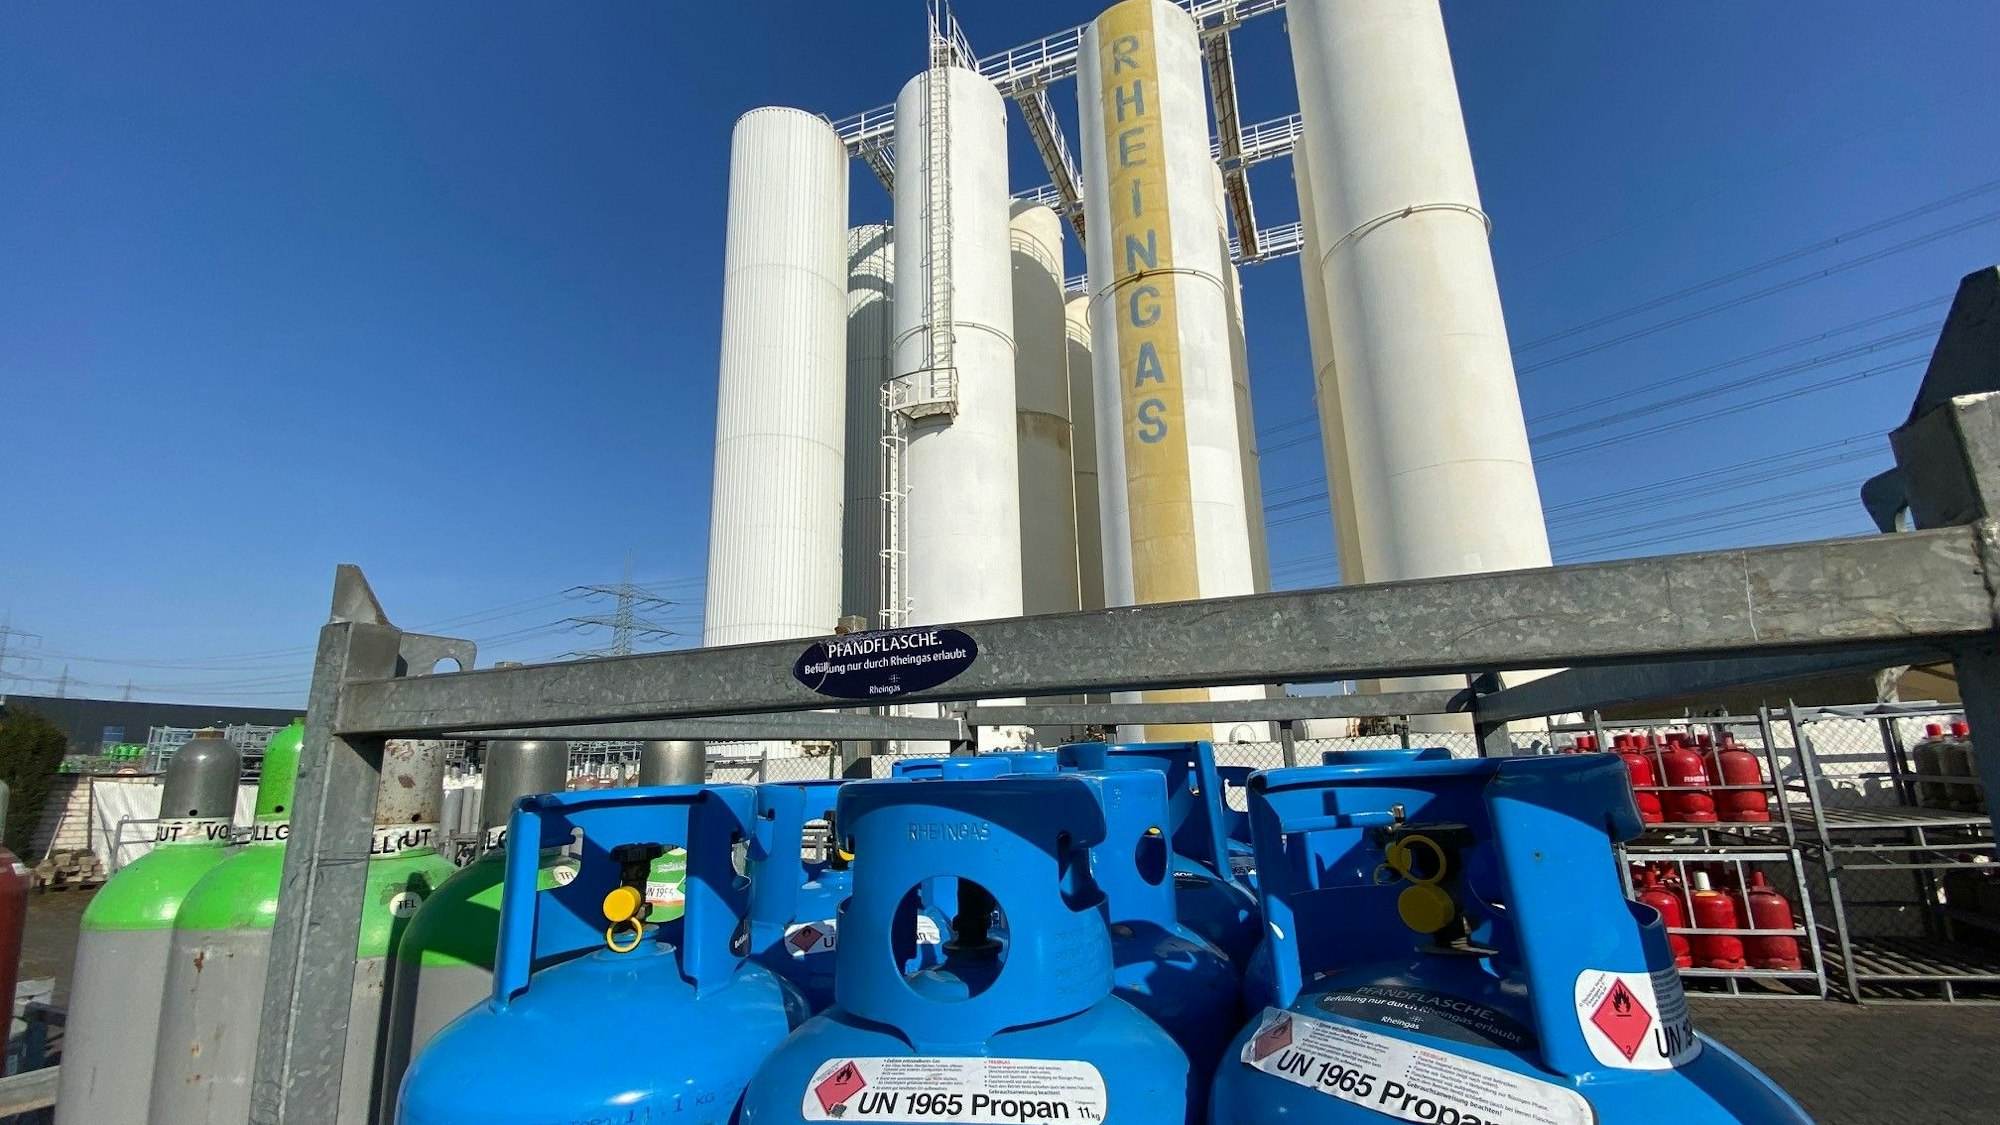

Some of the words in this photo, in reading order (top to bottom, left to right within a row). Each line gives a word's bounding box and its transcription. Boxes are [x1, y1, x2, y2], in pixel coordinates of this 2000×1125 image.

[1112, 35, 1168, 444] RHEINGAS
[828, 630, 943, 659] PFANDFLASCHE.
[804, 660, 846, 676] Befüllung
[847, 662, 862, 672] nur
[863, 657, 889, 670] durch
[890, 650, 932, 667] Rheingas
[932, 648, 967, 662] erlaubt
[869, 683, 900, 695] Rheingas
[908, 822, 991, 841] RHEINGAS
[1356, 985, 1495, 1022] PFANDFLASCHE.
[1324, 995, 1367, 1005] Befüllung
[1367, 998, 1387, 1007] nur
[1387, 999, 1418, 1011] durch
[1419, 1003, 1473, 1026] Rheingas
[1474, 1021, 1523, 1043] erlaubt
[1381, 1016, 1420, 1031] Rheingas
[1626, 1045, 1632, 1055] 2
[1655, 1024, 1681, 1058] UN
[1277, 1049, 1315, 1077] UN
[1316, 1062, 1377, 1098] 1965
[1378, 1079, 1500, 1125] Propa
[857, 1092, 899, 1115] UN
[906, 1092, 963, 1116] 1965
[971, 1093, 1070, 1123] Propan
